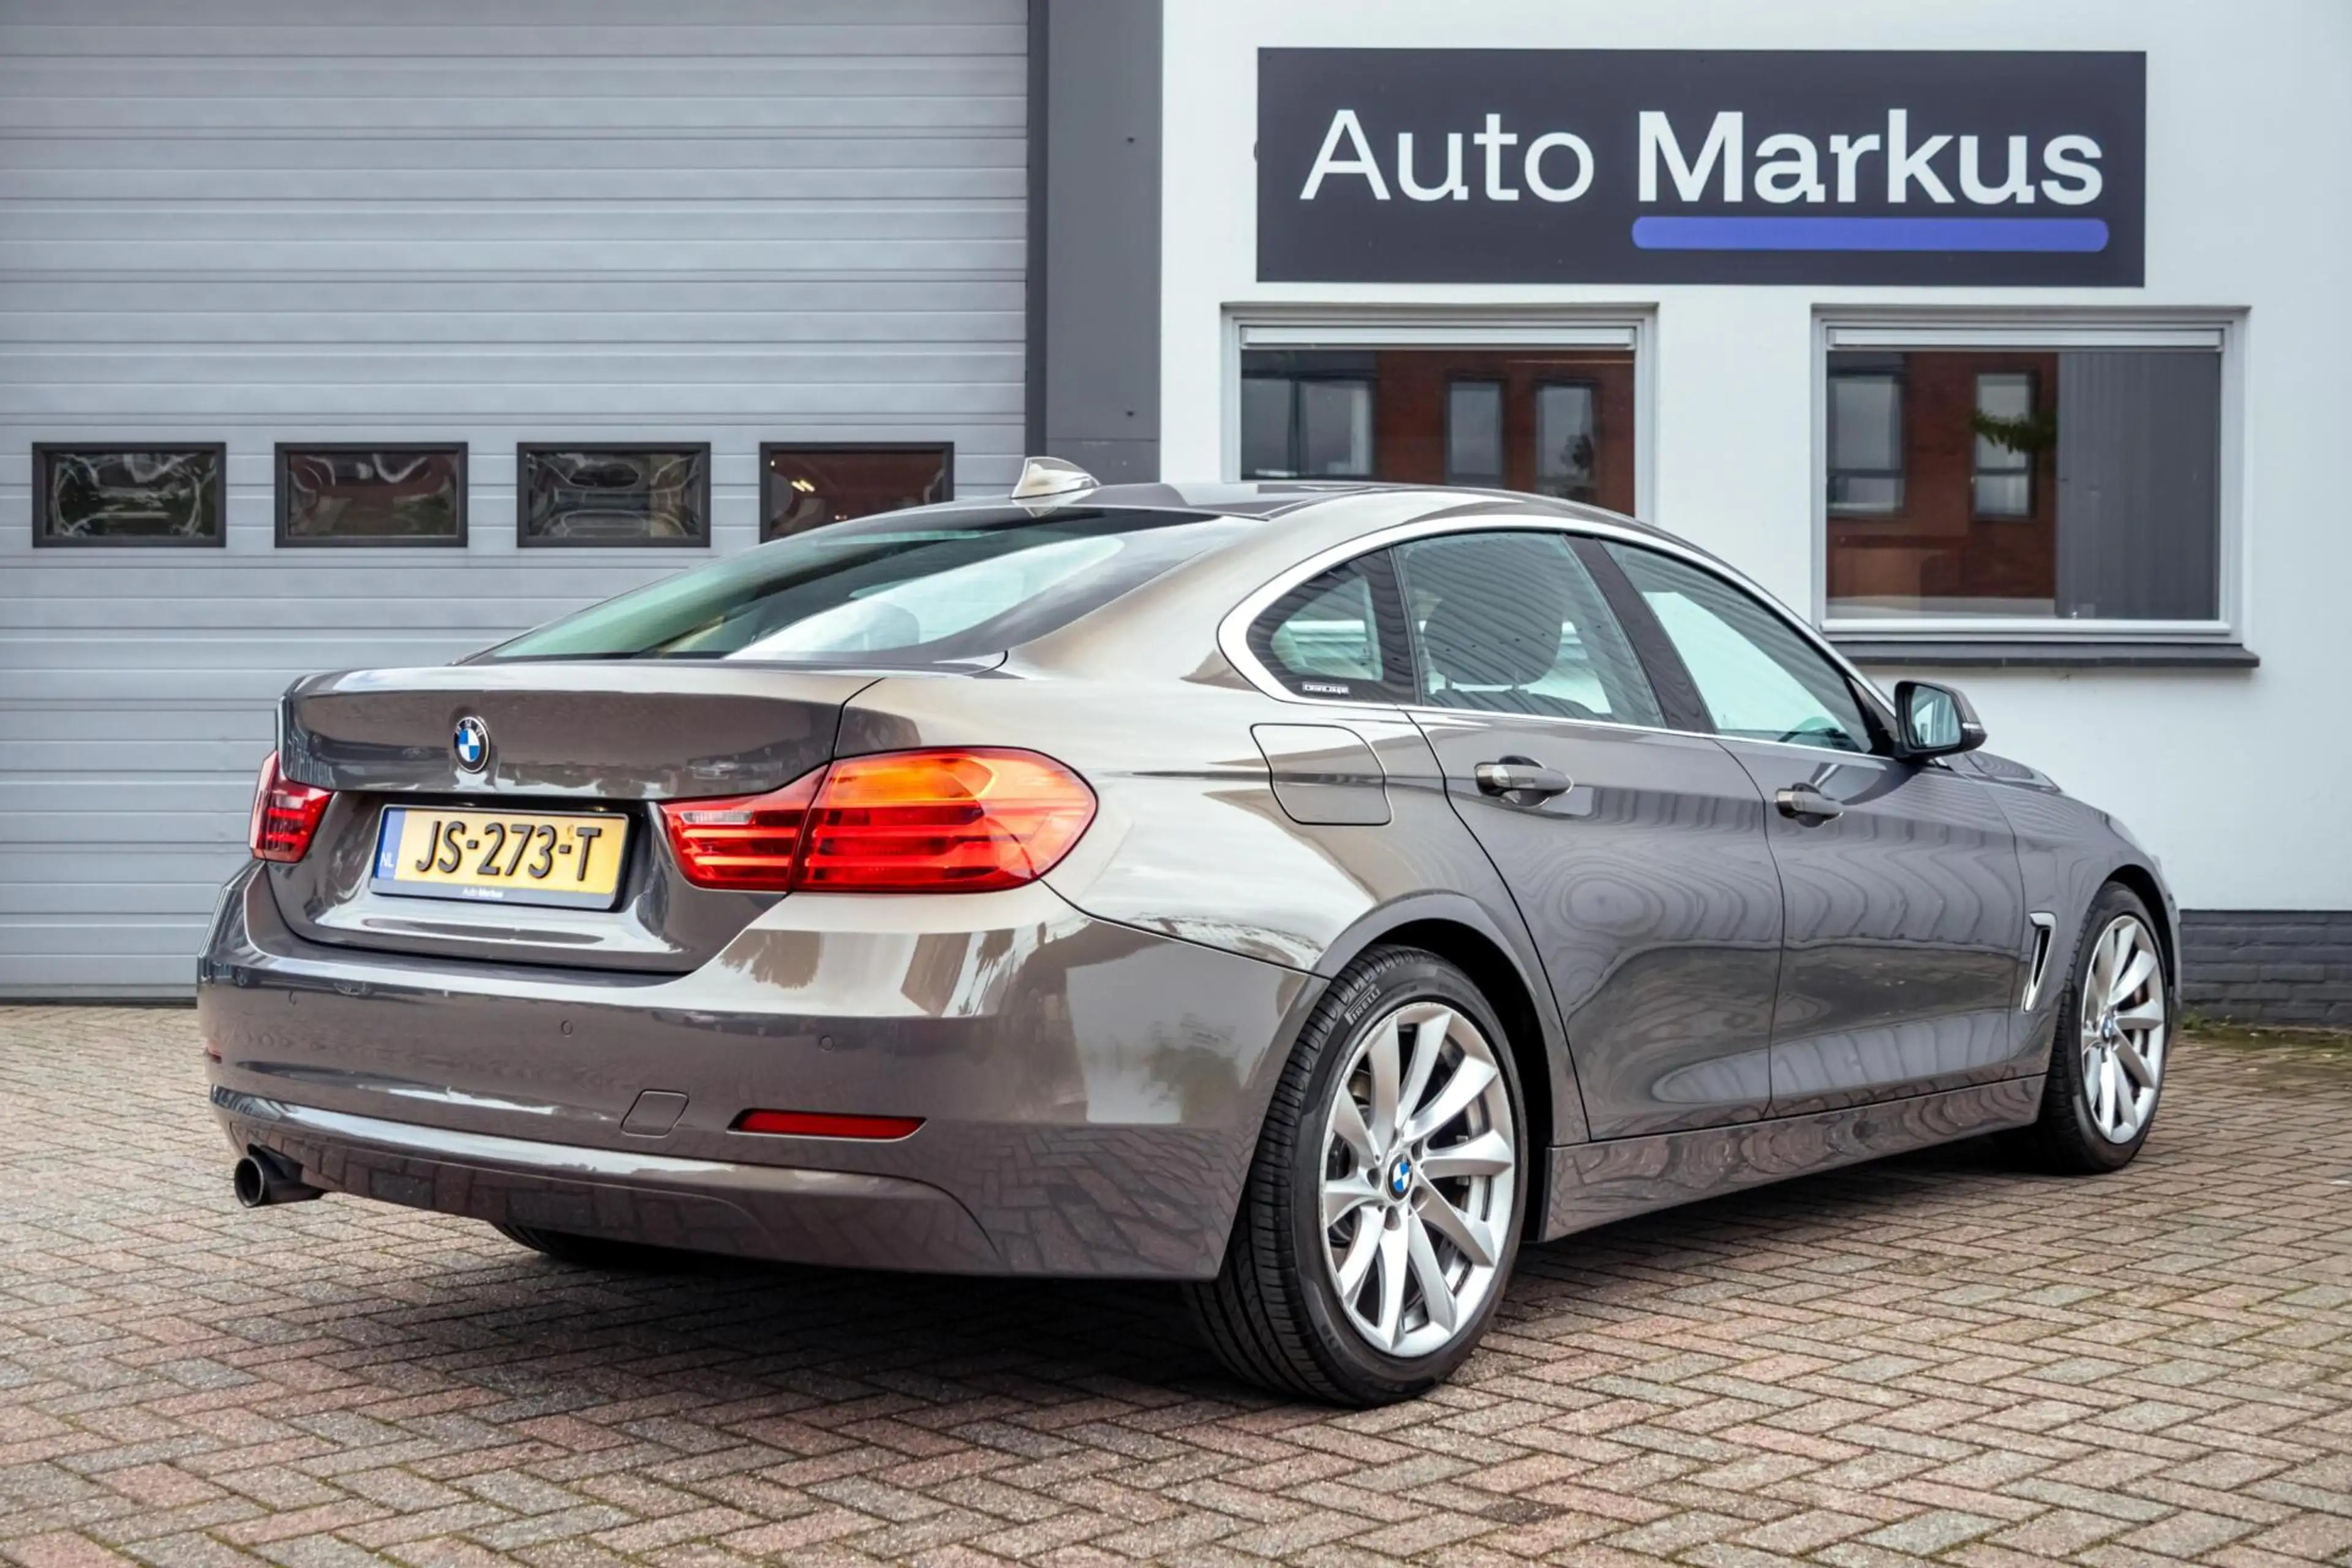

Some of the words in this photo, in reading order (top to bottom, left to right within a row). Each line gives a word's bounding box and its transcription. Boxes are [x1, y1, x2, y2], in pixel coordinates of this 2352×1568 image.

[1300, 109, 1594, 202] Auto
[1638, 108, 2101, 204] Markus
[380, 851, 394, 868] NL
[415, 820, 603, 882] JS-273-T
[1344, 982, 1381, 1026] PIRELLI
